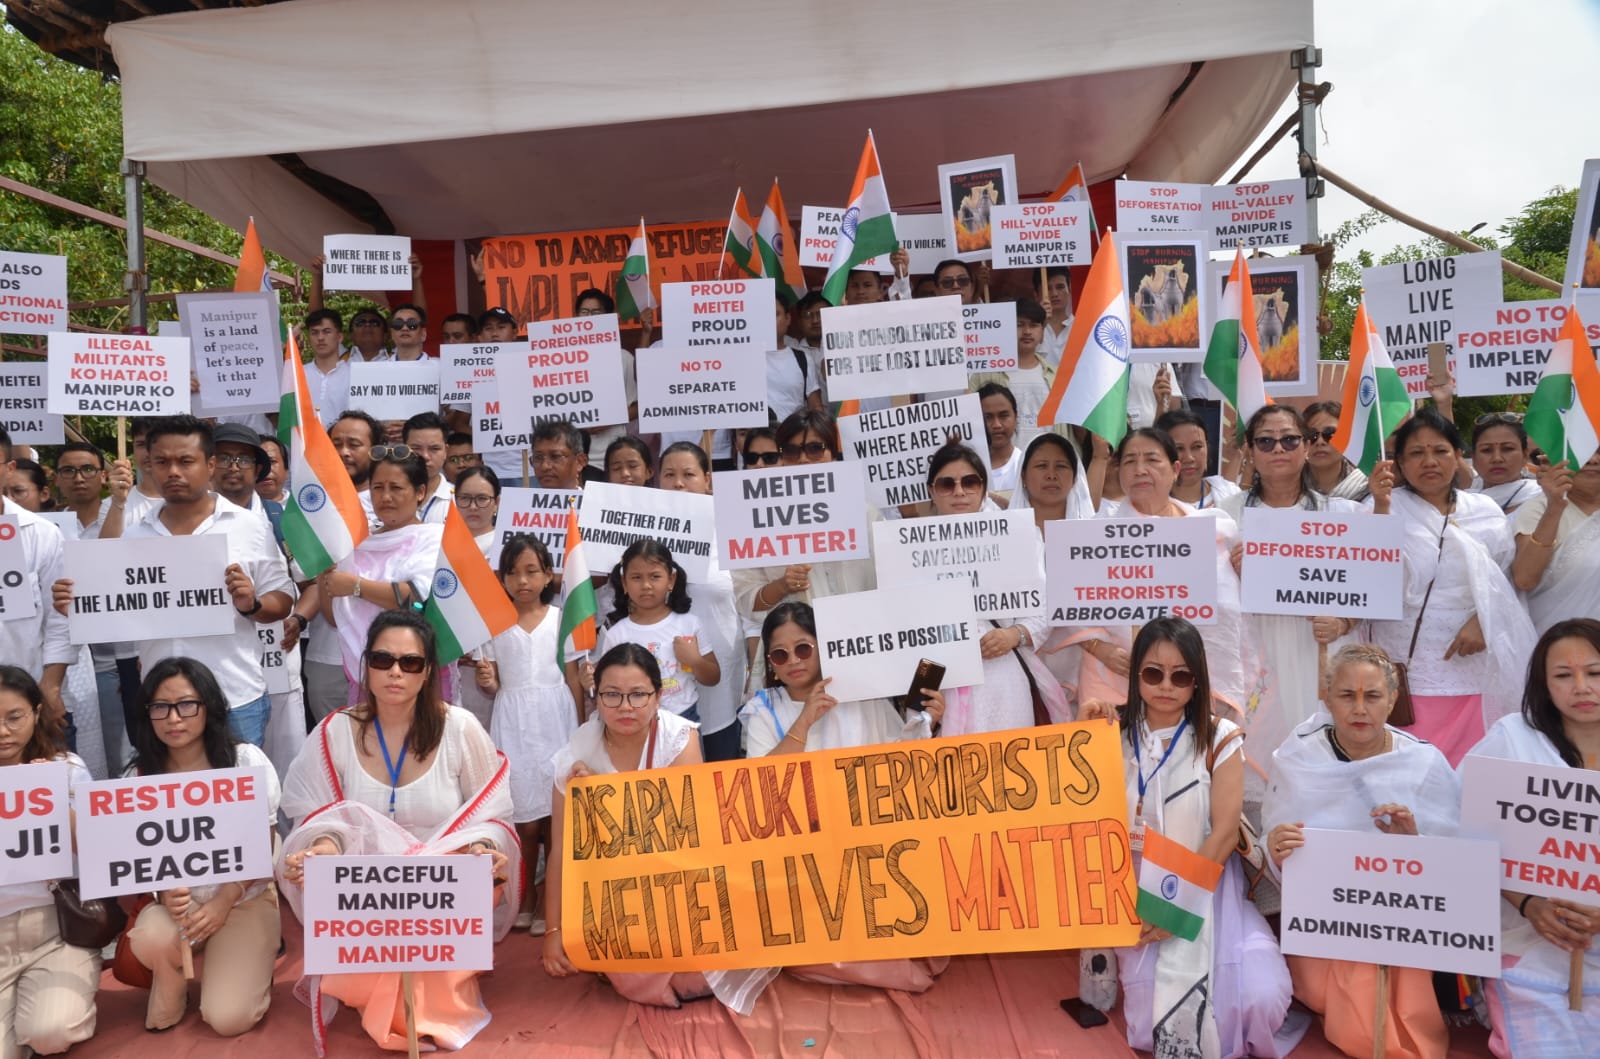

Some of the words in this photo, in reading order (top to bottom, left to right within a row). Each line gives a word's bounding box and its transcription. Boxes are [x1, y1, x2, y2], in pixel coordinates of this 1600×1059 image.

[1150, 188, 1178, 197] STOP
[1235, 184, 1270, 196] STOP
[1023, 206, 1055, 215] STOP
[1118, 200, 1202, 212] DEFORESTATIO
[1212, 195, 1295, 211] HILL-VALLEY
[1001, 216, 1078, 229] HILL-VALLEY
[1151, 215, 1179, 224] SAVE
[1231, 209, 1276, 222] DIVIDE
[1020, 230, 1061, 240] DIVIDE
[1216, 224, 1278, 236] MANIPUR
[1280, 220, 1292, 230] IS
[1005, 243, 1062, 253] MANIPUR
[1065, 241, 1076, 250] IS
[1248, 233, 1289, 246] STATE
[330, 250, 360, 260] WHERE
[364, 250, 390, 261] THERE
[393, 250, 401, 261] IS
[482, 241, 526, 269] NO
[535, 238, 563, 267] TO
[1008, 256, 1033, 266] HILL
[1035, 254, 1074, 264] STATE
[2, 263, 43, 276] ALSO
[326, 264, 348, 274] LOVE
[351, 264, 377, 275] THERE
[380, 264, 388, 275] IS
[392, 264, 408, 275] LIFE
[1403, 258, 1456, 284] LONG
[691, 282, 746, 296] PROUD
[693, 301, 744, 314] MEITEI
[1409, 288, 1453, 314] LIVE
[200, 310, 257, 323] Manipur
[1496, 308, 1531, 325] NO
[1536, 306, 1568, 322] TO
[204, 327, 215, 337] is
[229, 325, 258, 336] land
[552, 323, 572, 334] NO
[575, 321, 593, 331] TO
[692, 319, 747, 332] PROUD
[88, 338, 153, 352] ILLEGAL
[204, 341, 216, 352] of
[531, 331, 617, 350] FOREIGNERS!
[826, 331, 854, 350] OUR
[472, 346, 499, 355] STOP
[73, 353, 166, 367] MILITANTS
[235, 356, 264, 367] keep
[528, 350, 589, 368] PROUD
[681, 362, 700, 372] NO
[704, 360, 721, 370] TO
[827, 357, 852, 376] FOR
[857, 354, 883, 373] THE
[887, 351, 920, 370] LOST
[925, 346, 964, 368] LIVES
[990, 359, 1016, 368] SOO
[71, 368, 101, 380] KO
[105, 369, 168, 382] HATAO!
[217, 372, 227, 382] it
[230, 371, 256, 381] that
[532, 370, 589, 388] MEITEI
[64, 383, 146, 397] MANIPUR
[150, 386, 175, 397] KO
[226, 387, 251, 397] way
[350, 386, 368, 397] SAY
[371, 386, 383, 396] NO
[386, 385, 396, 396] TO
[400, 384, 438, 396] VIOLENCE
[668, 381, 736, 395] SEPARATE
[78, 399, 161, 412] BACHAO!
[533, 390, 593, 409] PROUD
[643, 401, 764, 418] ADMINISTRATION!
[859, 408, 905, 432] HELLO
[908, 398, 959, 425] MODIJI
[854, 433, 907, 459] WHERE
[911, 428, 941, 450] ARE
[868, 457, 926, 483] PLEASE
[743, 472, 835, 500] MEITEI
[600, 509, 655, 529] TOGETHER
[658, 516, 680, 533] FOR
[682, 520, 691, 534] A
[752, 502, 830, 528] LIVES
[899, 525, 936, 545] SAVE
[939, 519, 1009, 541] MANIPUR
[1104, 524, 1154, 538] STOP
[1300, 522, 1348, 537] STOP
[729, 528, 857, 560] MATTER!
[1070, 544, 1191, 560] PROTECTING
[1246, 541, 1400, 563] DEFORESTATION!
[912, 548, 950, 568] SAVE
[125, 567, 166, 585] SAVE
[1107, 566, 1154, 580] KUKI
[1299, 567, 1347, 583] SAVE
[74, 595, 101, 614] THE
[106, 592, 147, 611] LAND
[152, 590, 170, 609] OF
[176, 587, 227, 608] JEWEL
[1074, 585, 1189, 601] TERRORISTS
[1276, 589, 1368, 607] MANIPUR!
[1052, 606, 1168, 621] ABBROGATE
[1172, 605, 1213, 620] SOO
[827, 635, 875, 659] PEACE
[878, 633, 894, 651] IS
[898, 622, 970, 649] POSSIBLE
[89, 776, 255, 816] RESTORE
[571, 775, 700, 860] DISARM
[713, 761, 819, 844] KUKI
[836, 730, 1099, 826] TERRORISTS
[136, 815, 216, 848] OUR
[5, 824, 61, 859] JI!
[109, 846, 245, 887] PEACE!
[1354, 856, 1389, 872] NO
[1392, 859, 1423, 876] TO
[334, 865, 458, 884] PEACEFUL
[582, 866, 738, 960] MEITEI
[753, 839, 928, 947] LIVES
[939, 818, 1141, 931] MATTER
[337, 891, 454, 911] MANIPUR
[1332, 887, 1446, 913] SEPARATE
[313, 918, 483, 938] PROGRESSIVE
[1287, 917, 1495, 952] ADMINISTRATION!
[338, 944, 455, 964] MANIPUR
